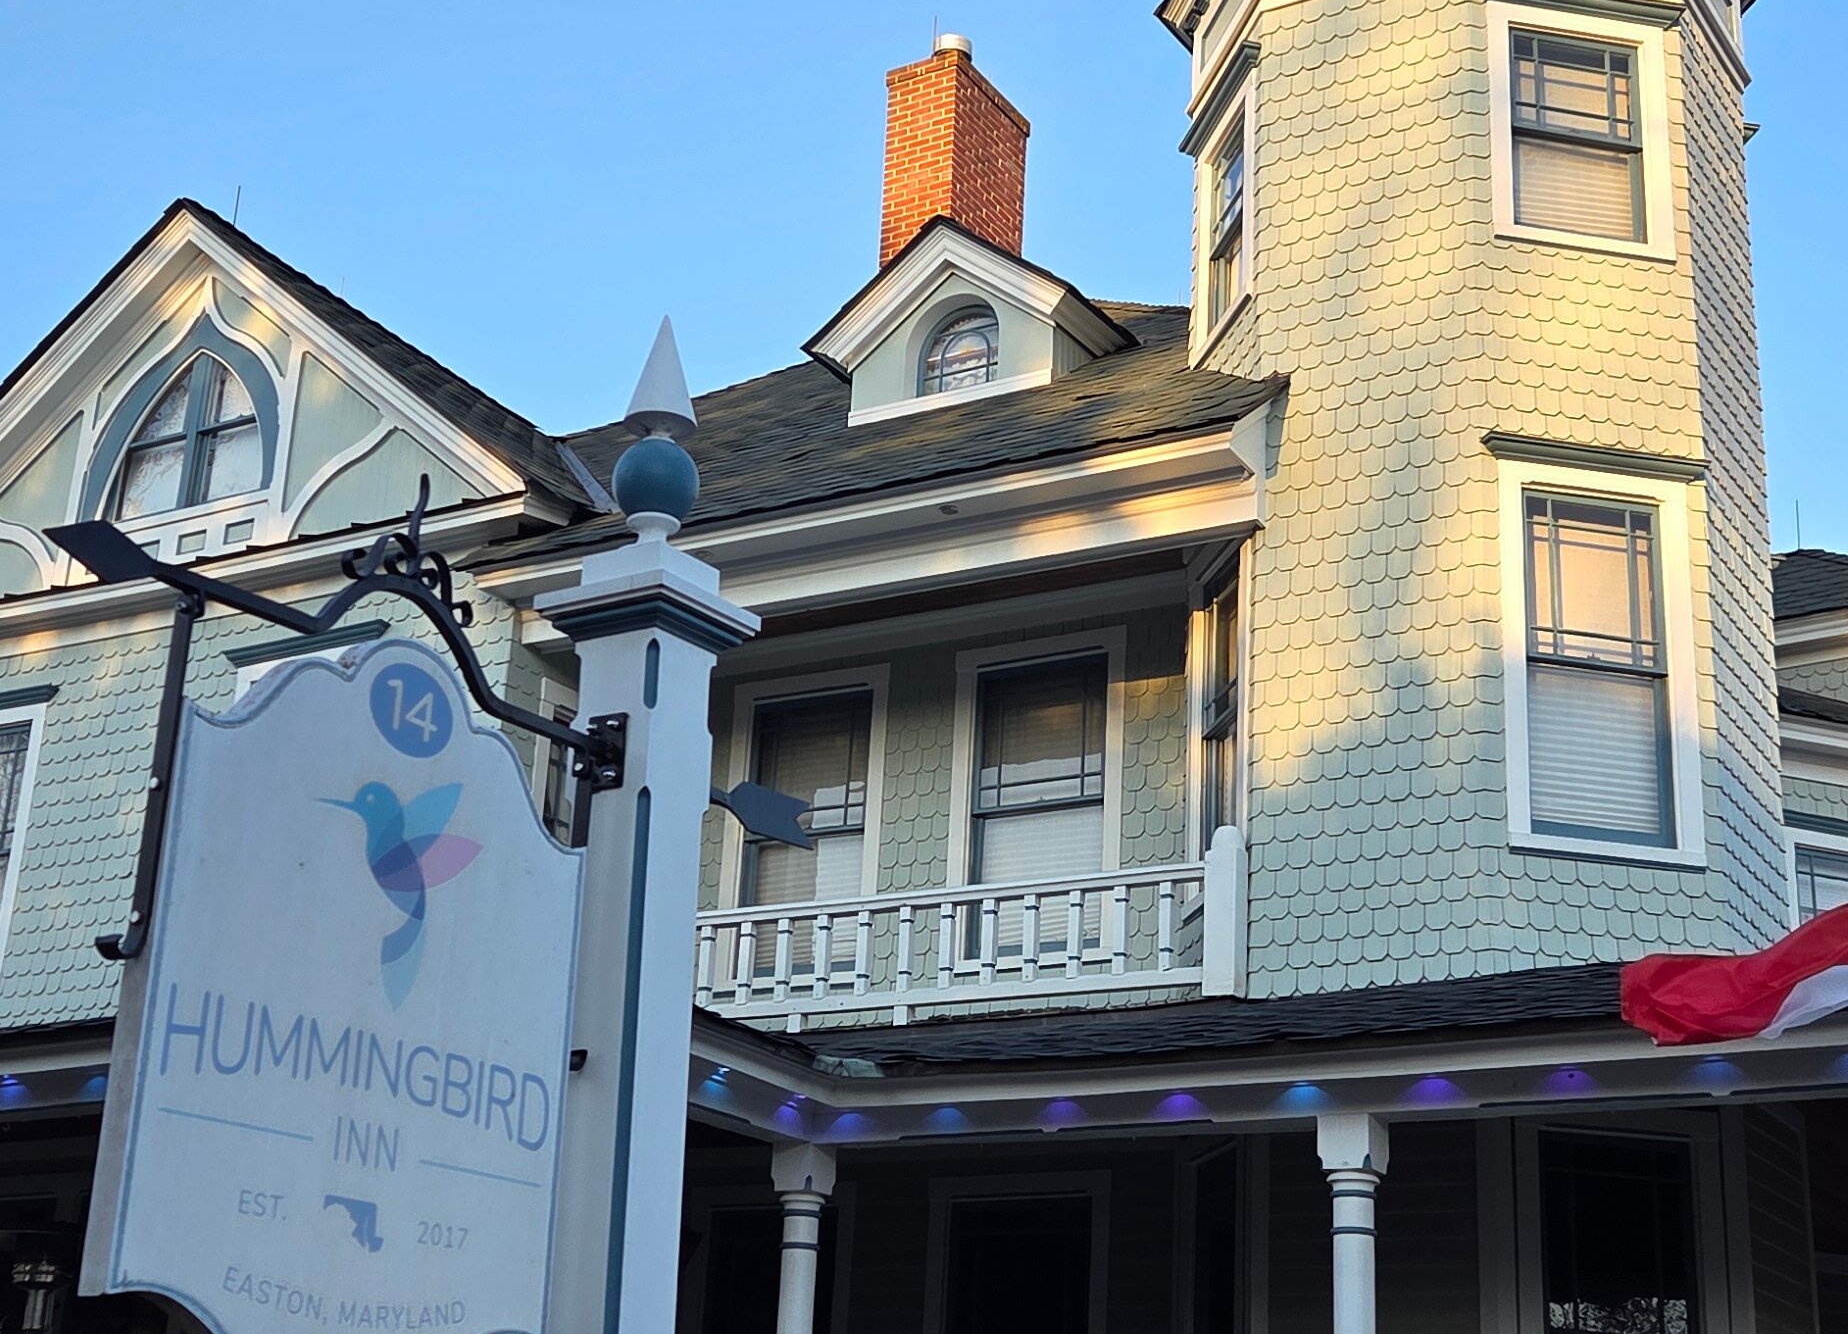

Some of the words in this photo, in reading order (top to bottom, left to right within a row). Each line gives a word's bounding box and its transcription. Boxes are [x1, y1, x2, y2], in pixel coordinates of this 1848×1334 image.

[386, 679, 438, 743] 14
[160, 982, 550, 1152] HUMMINGBIRD
[333, 1115, 399, 1173] INN
[237, 1188, 288, 1222] EST.
[416, 1219, 469, 1252] 2017
[222, 1266, 328, 1325] EASTON,
[337, 1300, 467, 1330] MARYLAND
